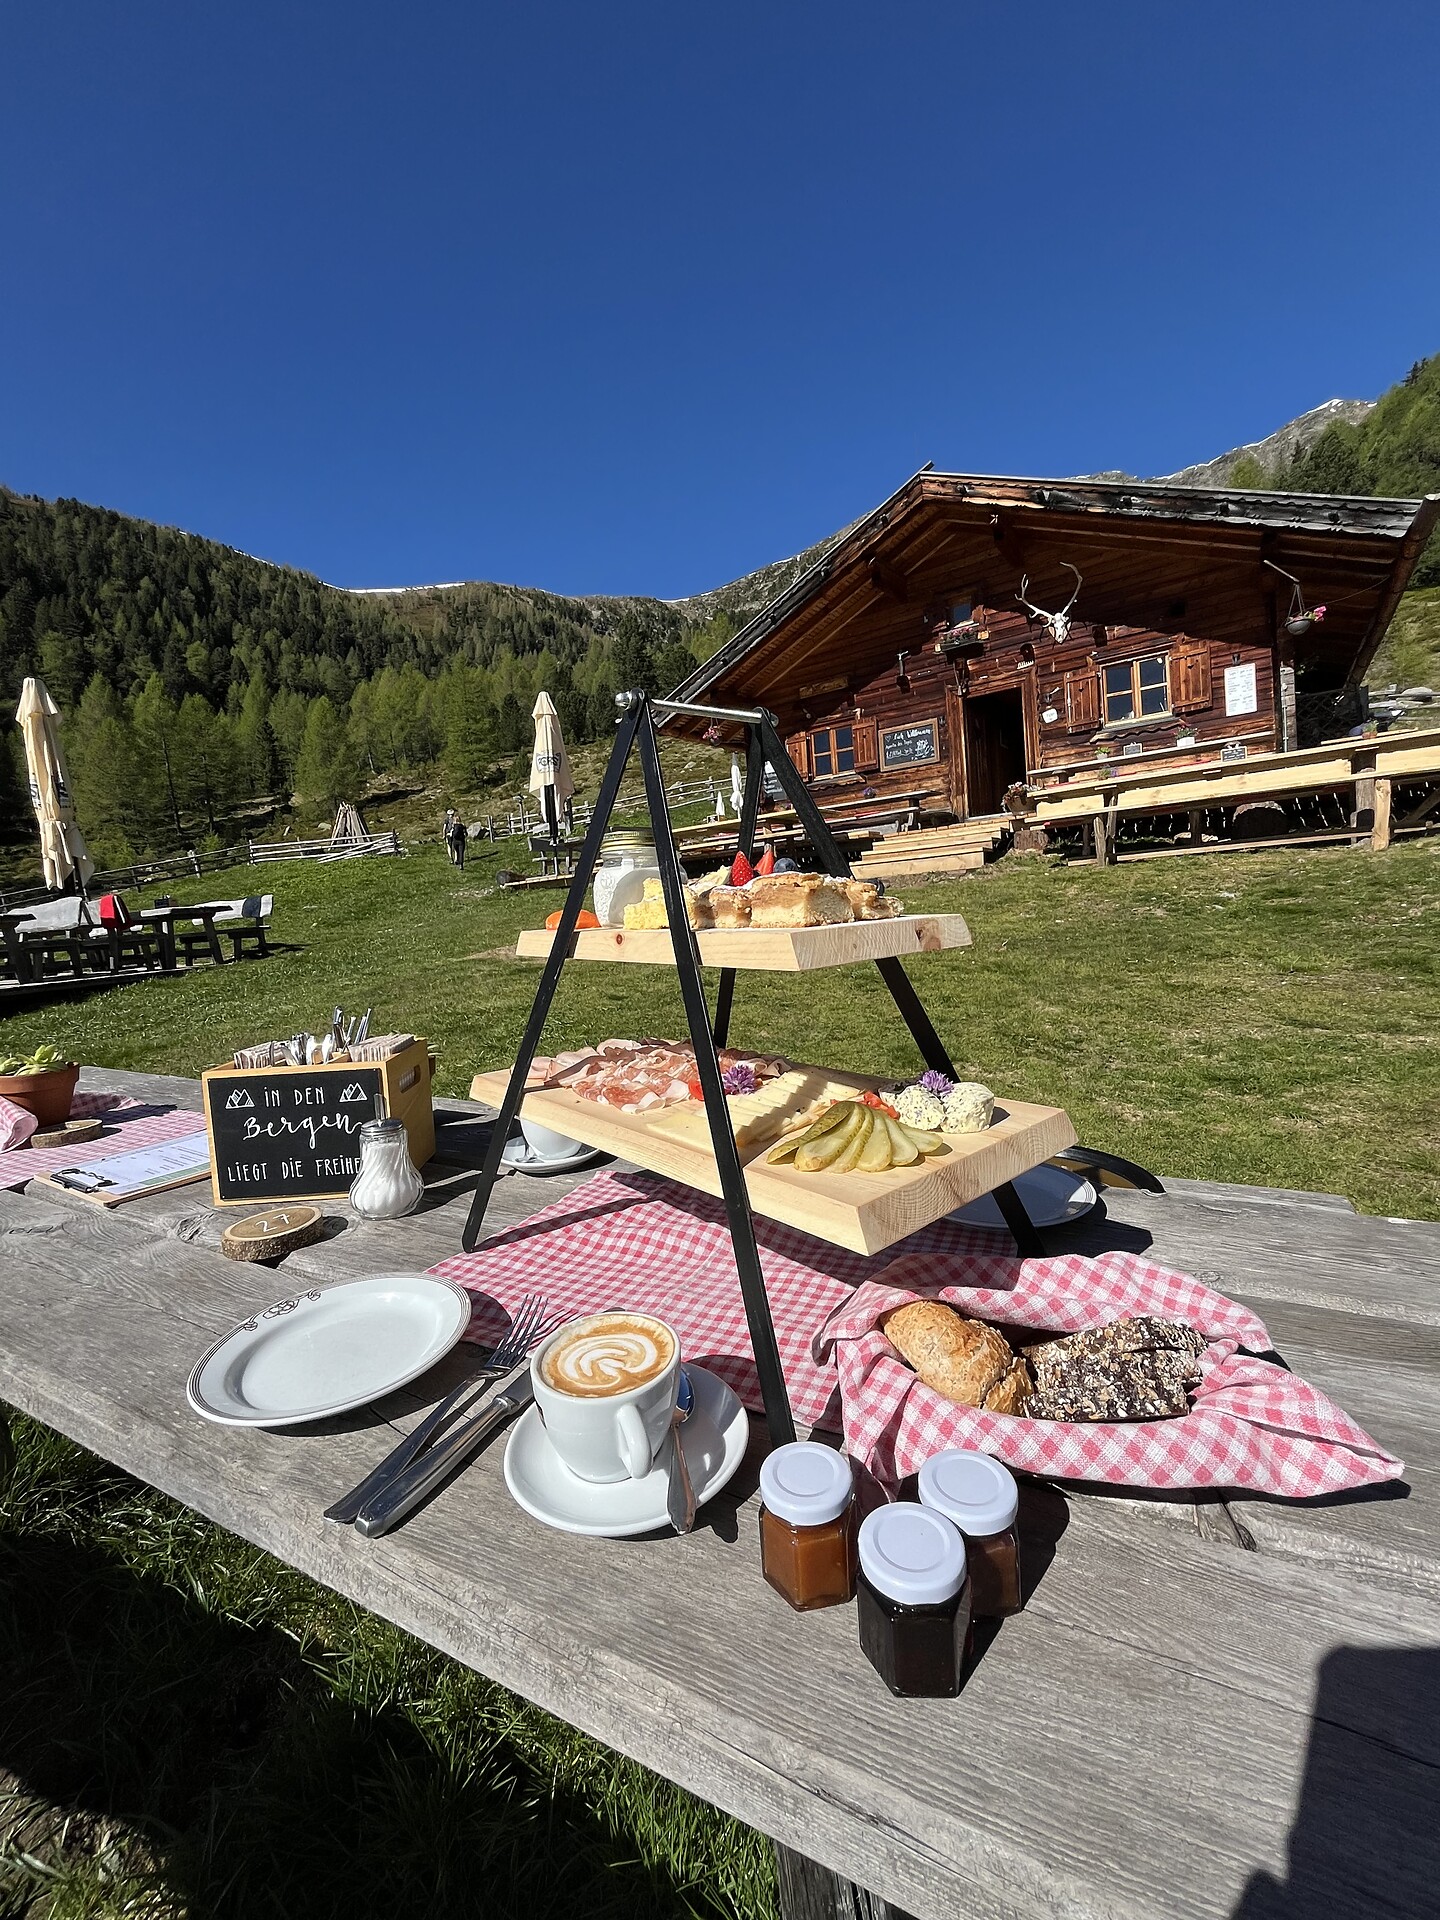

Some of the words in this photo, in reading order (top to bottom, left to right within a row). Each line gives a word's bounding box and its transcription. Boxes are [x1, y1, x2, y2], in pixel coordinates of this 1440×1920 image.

[294, 1086, 325, 1106] DEN
[242, 1112, 362, 1149] Bergen
[315, 1154, 361, 1177] FREIHE
[255, 1213, 291, 1233] 27
